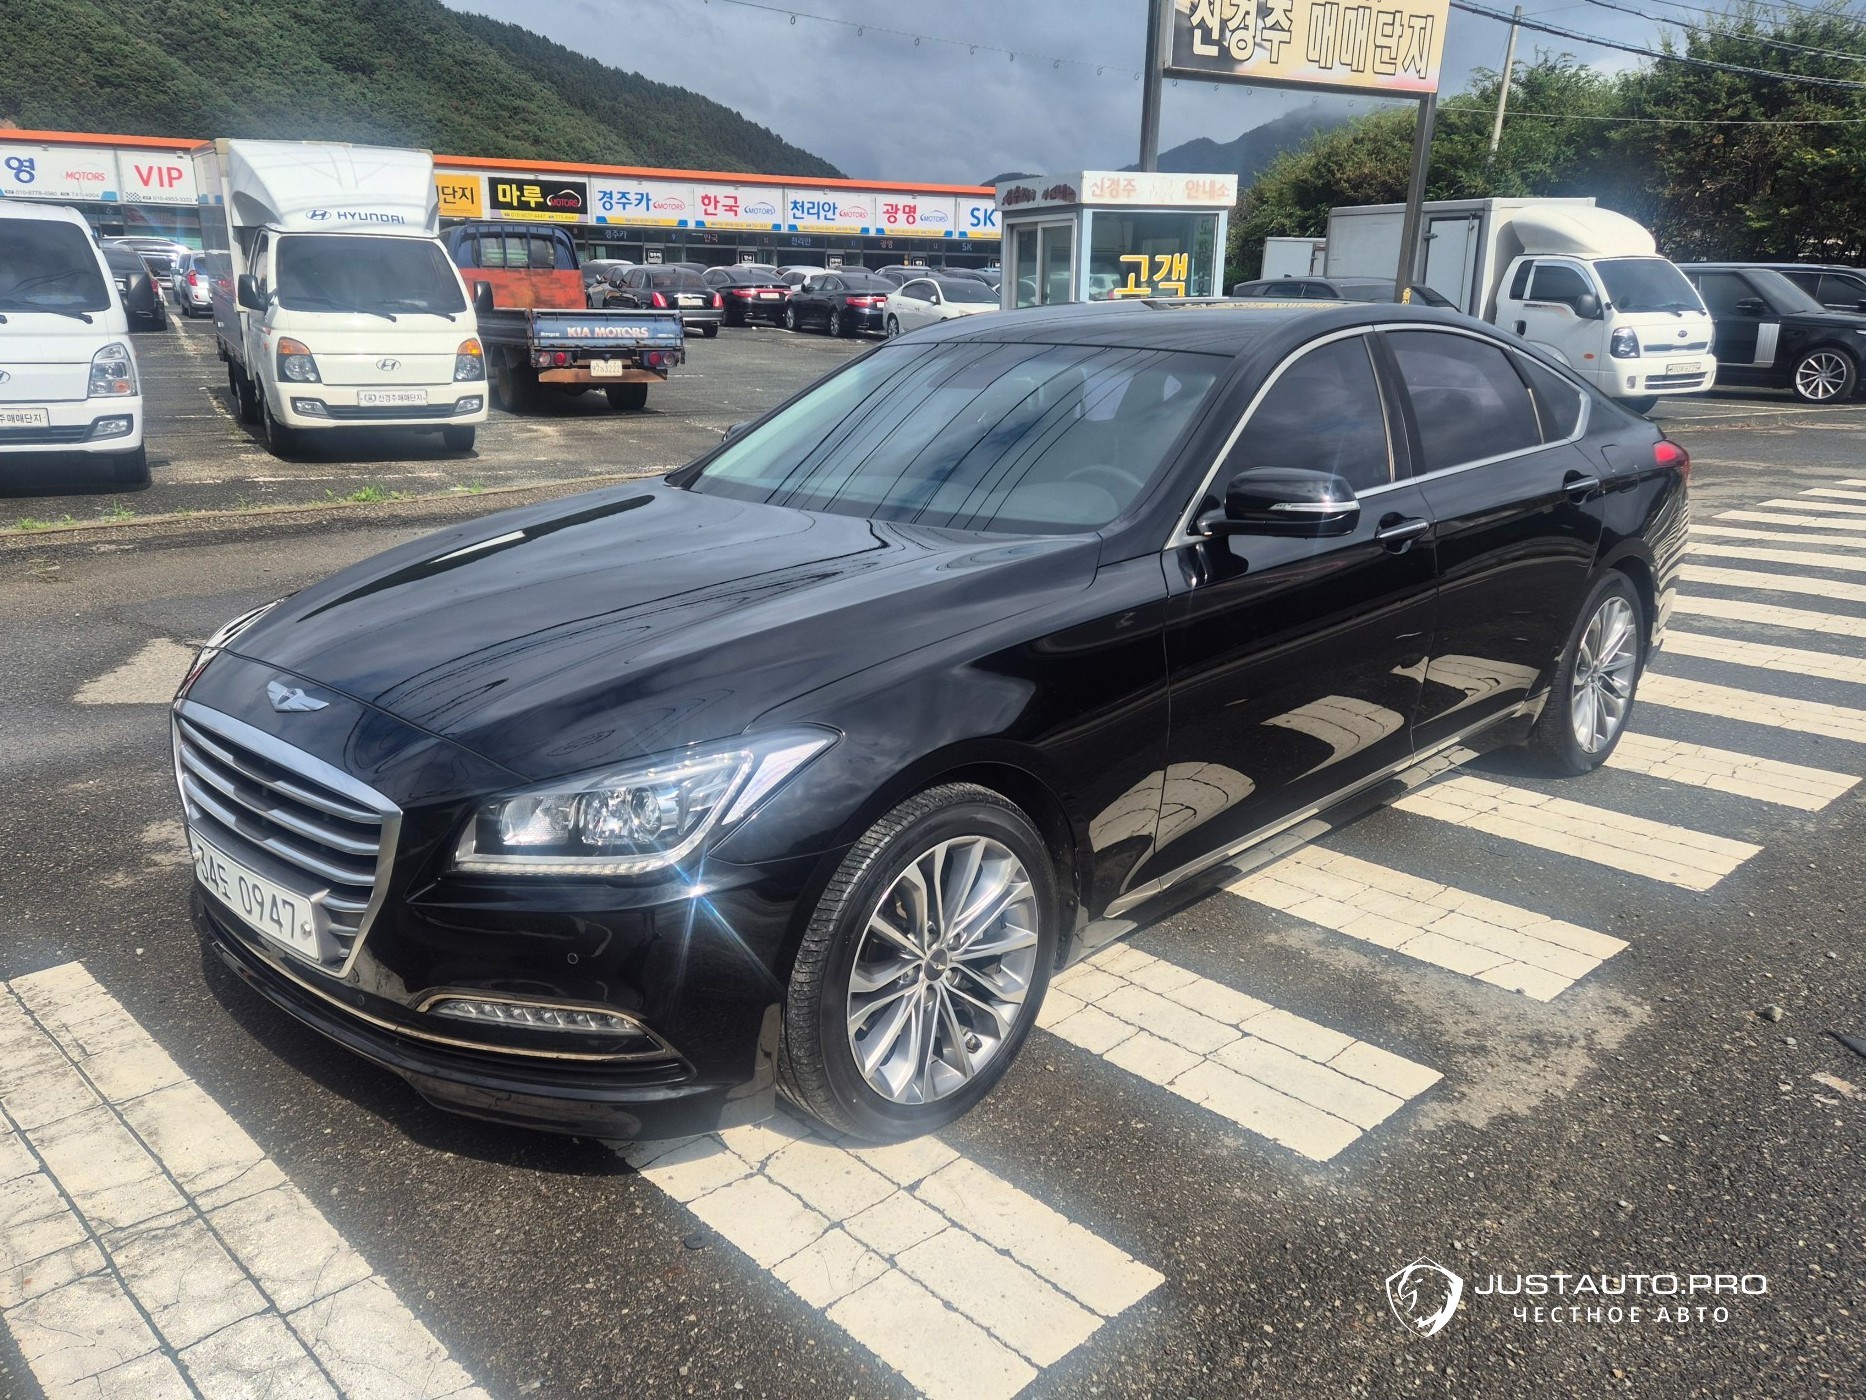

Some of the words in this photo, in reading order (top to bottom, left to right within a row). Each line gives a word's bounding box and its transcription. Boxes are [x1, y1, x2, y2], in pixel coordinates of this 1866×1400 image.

[1190, 0, 1293, 64] 신경주
[1306, 2, 1434, 79] 매매단지
[4, 156, 36, 184] 영
[65, 171, 105, 182] MOTORS
[134, 165, 183, 188] VIP
[435, 184, 475, 205] 단지
[497, 183, 544, 207] 마루
[551, 199, 579, 208] MOTORS
[1090, 177, 1137, 199] 신경주
[1184, 179, 1231, 200] 안내소
[598, 190, 652, 212] 경주카
[656, 203, 684, 211] MOTORS
[701, 194, 740, 217] 한국
[748, 207, 774, 216] MOTORS
[790, 199, 838, 221] 천리안
[842, 211, 867, 219] MOTORS
[336, 211, 405, 225] HYUNDAI
[882, 203, 917, 225] 광명
[923, 215, 948, 223] MOTORS
[969, 207, 996, 227] SK
[604, 229, 627, 240] 경주카
[962, 242, 973, 251] SK
[1114, 253, 1189, 298] 고객
[567, 326, 591, 338] KIA
[594, 326, 649, 338] MOTORS
[238, 873, 296, 940] 0947
